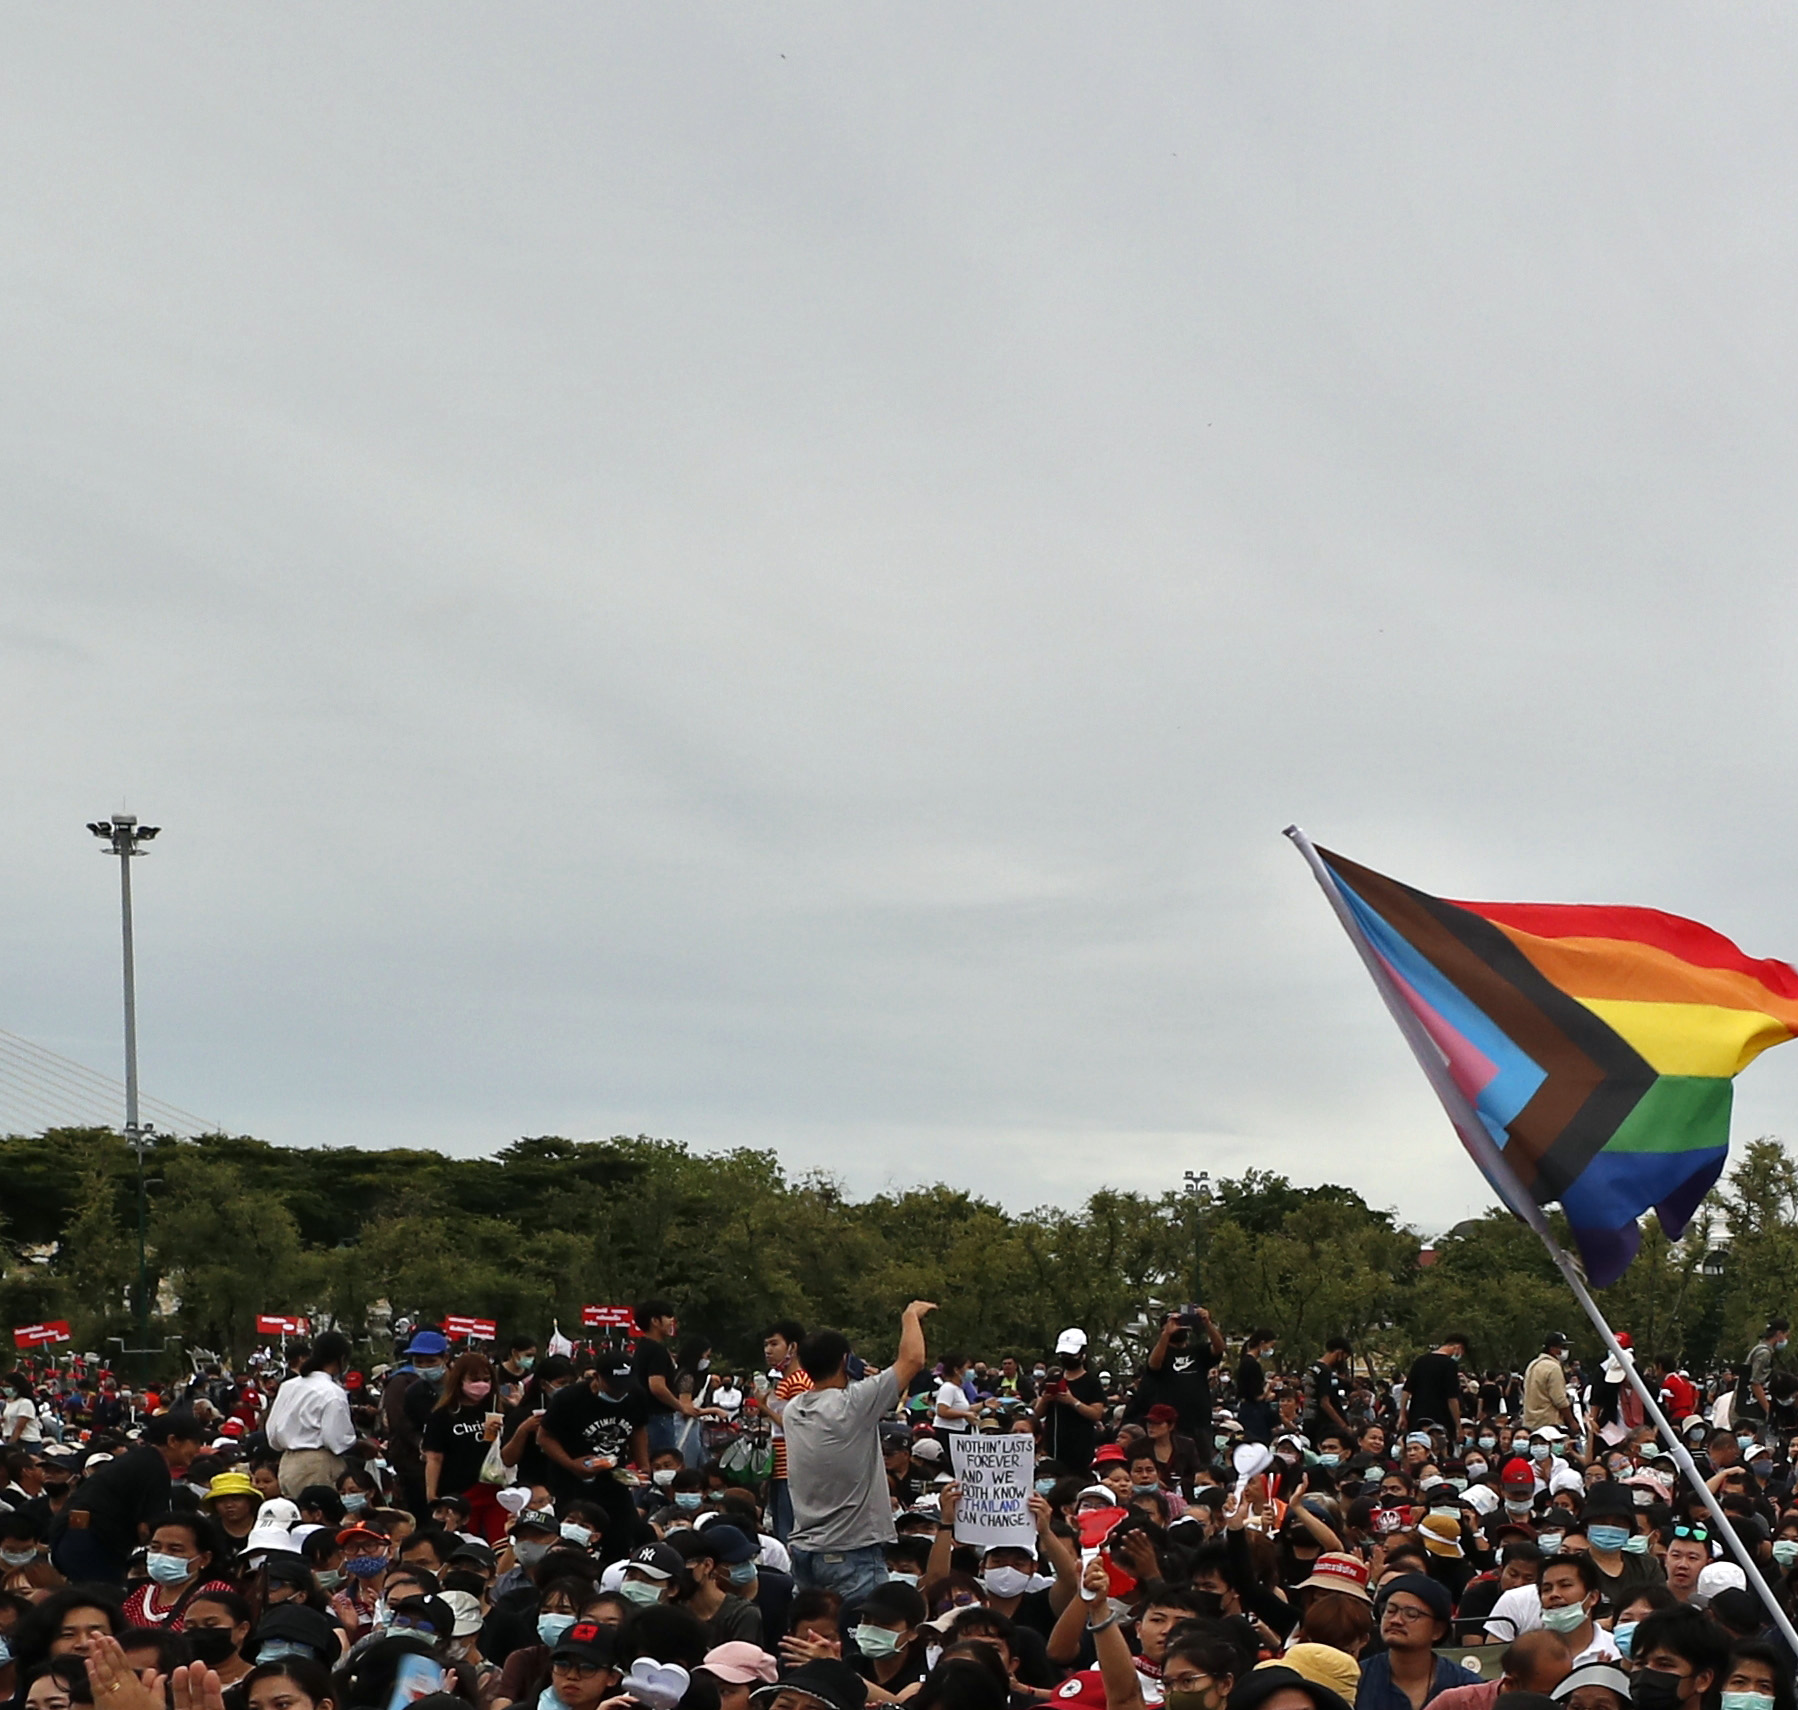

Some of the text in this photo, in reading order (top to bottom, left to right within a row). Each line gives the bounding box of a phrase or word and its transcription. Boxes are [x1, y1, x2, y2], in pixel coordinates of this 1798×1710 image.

[957, 1440, 1033, 1454] NOTHIN' LASTS
[967, 1454, 1023, 1468] FOREVER.
[962, 1471, 1015, 1484] AND WE
[962, 1486, 1026, 1500] BOTH KNOW
[965, 1499, 1020, 1513] THAILAND
[957, 1510, 1031, 1527] CAN CHANGE.
